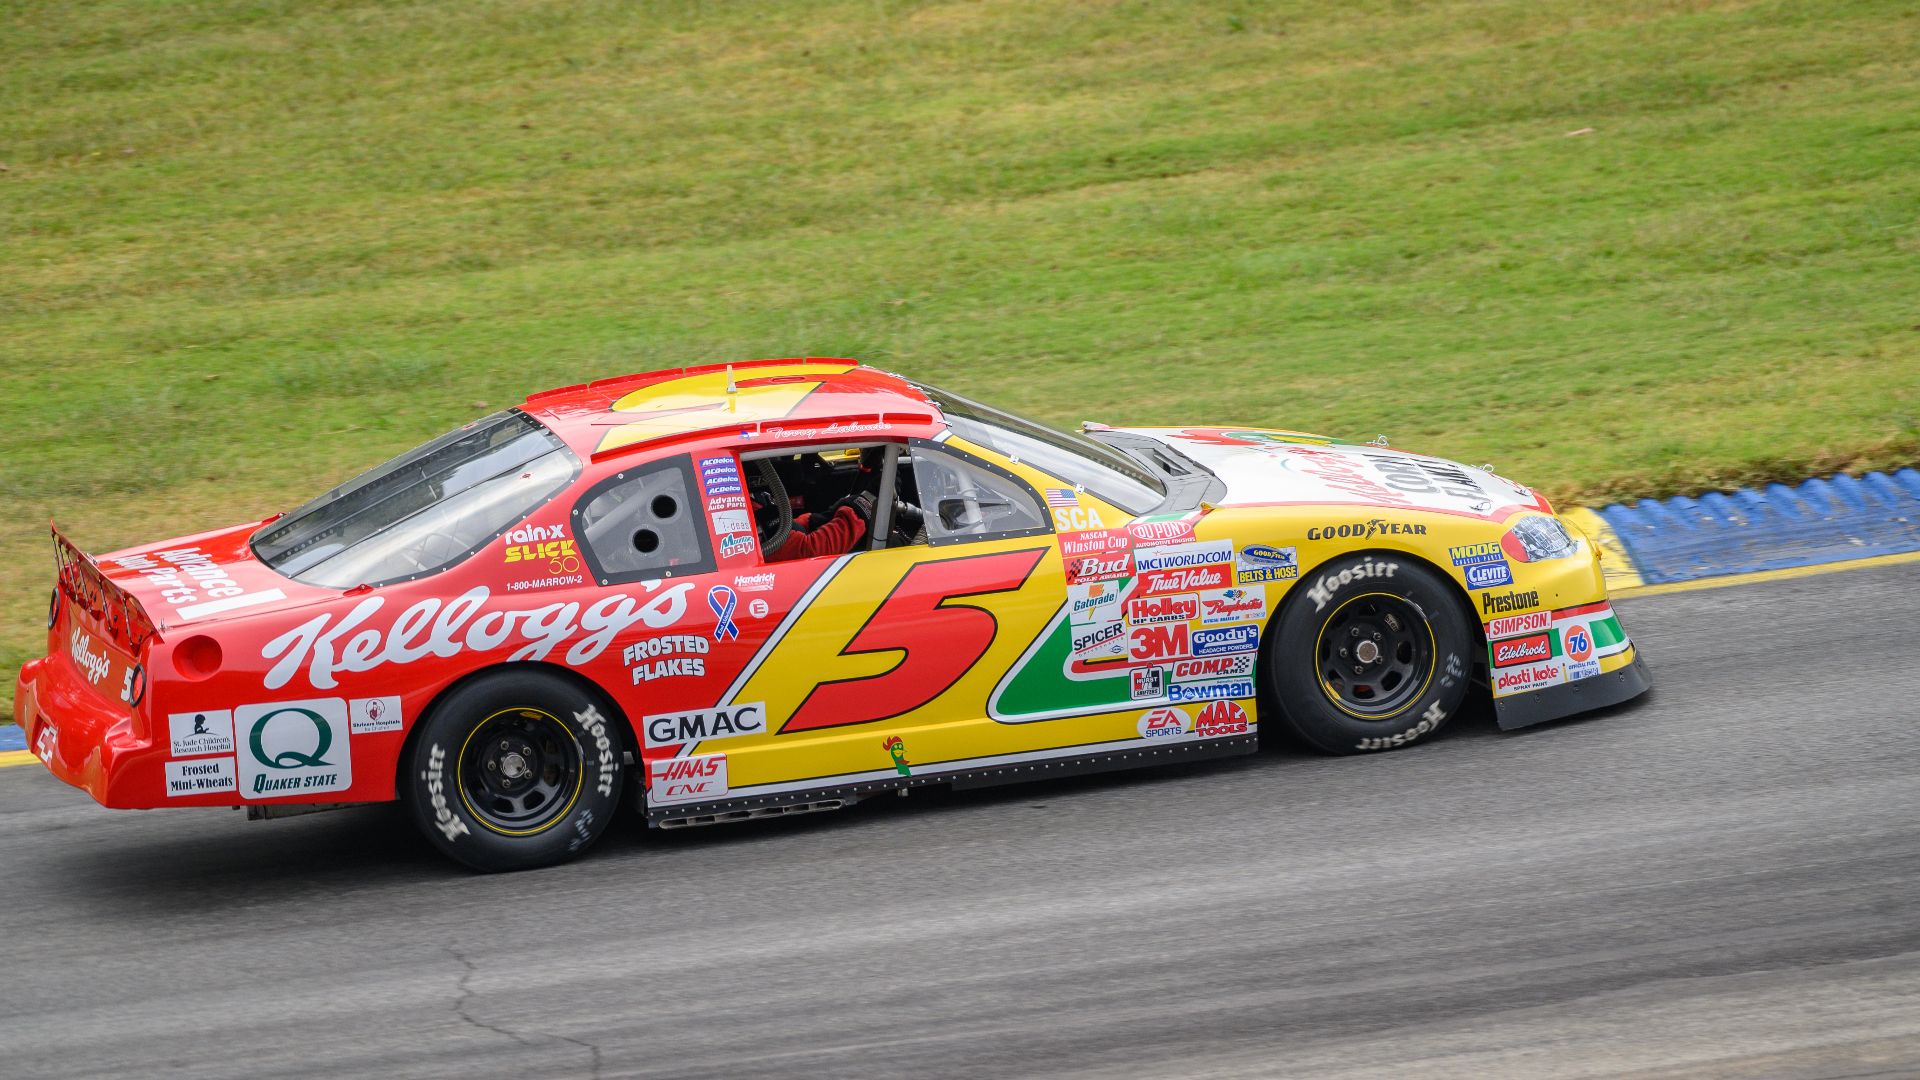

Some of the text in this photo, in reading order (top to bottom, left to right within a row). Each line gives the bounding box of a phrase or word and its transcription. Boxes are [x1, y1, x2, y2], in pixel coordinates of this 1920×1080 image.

[710, 496, 746, 506] Advance
[726, 501, 746, 509] Parts
[1055, 507, 1104, 531] SCA
[1063, 536, 1128, 554] Winston Cup
[1080, 531, 1108, 541] NASCAR
[504, 540, 577, 563] SLICK
[723, 542, 754, 559] DEW
[1451, 543, 1500, 560] MOOG
[154, 547, 244, 598] Advance
[548, 556, 580, 575] 50
[1076, 553, 1131, 577] Bud
[1239, 566, 1297, 583] BELTS & HOSE
[1469, 566, 1507, 582] CLEVITE
[139, 567, 198, 604] Parts
[506, 575, 583, 591] 1-800-MARROW-2
[734, 572, 776, 587] Hendrick
[1306, 556, 1399, 613] Hoosier
[1074, 593, 1115, 612] Gatorade
[1131, 597, 1196, 619] Holley
[1482, 590, 1540, 615] Prestone
[1493, 613, 1548, 635] SIMPSON
[263, 581, 695, 689] Kellogg's
[775, 546, 1051, 735] 5
[1073, 622, 1123, 651] SPICER
[1130, 623, 1189, 660] 3M
[1193, 627, 1257, 644] Goody's
[1568, 632, 1588, 654] 76
[71, 626, 110, 685] Kellogg's
[623, 635, 710, 667] FROSTED
[1198, 643, 1254, 654] HEADACHE POWDERS
[1497, 641, 1547, 661] Edelbrock
[632, 658, 705, 686] FLAKES
[1175, 657, 1234, 677] COMP
[1216, 667, 1245, 676] CAMS
[120, 666, 134, 701] 5
[1136, 676, 1158, 684] HURST
[1498, 666, 1531, 689] plasti
[1533, 665, 1559, 682] kote
[649, 706, 762, 742] GMAC
[1146, 710, 1182, 729] EA
[1196, 701, 1248, 728] MAC
[1146, 726, 1182, 738] SPORTS
[1196, 722, 1248, 737] TOOLS
[174, 743, 231, 754] Research Hospital
[183, 739, 197, 747] Jude
[182, 763, 220, 776] Frosted
[660, 757, 722, 781] HAAS
[170, 776, 233, 791] Mini-Wheats
[304, 773, 338, 788] STATE
[666, 782, 714, 796] CNC
